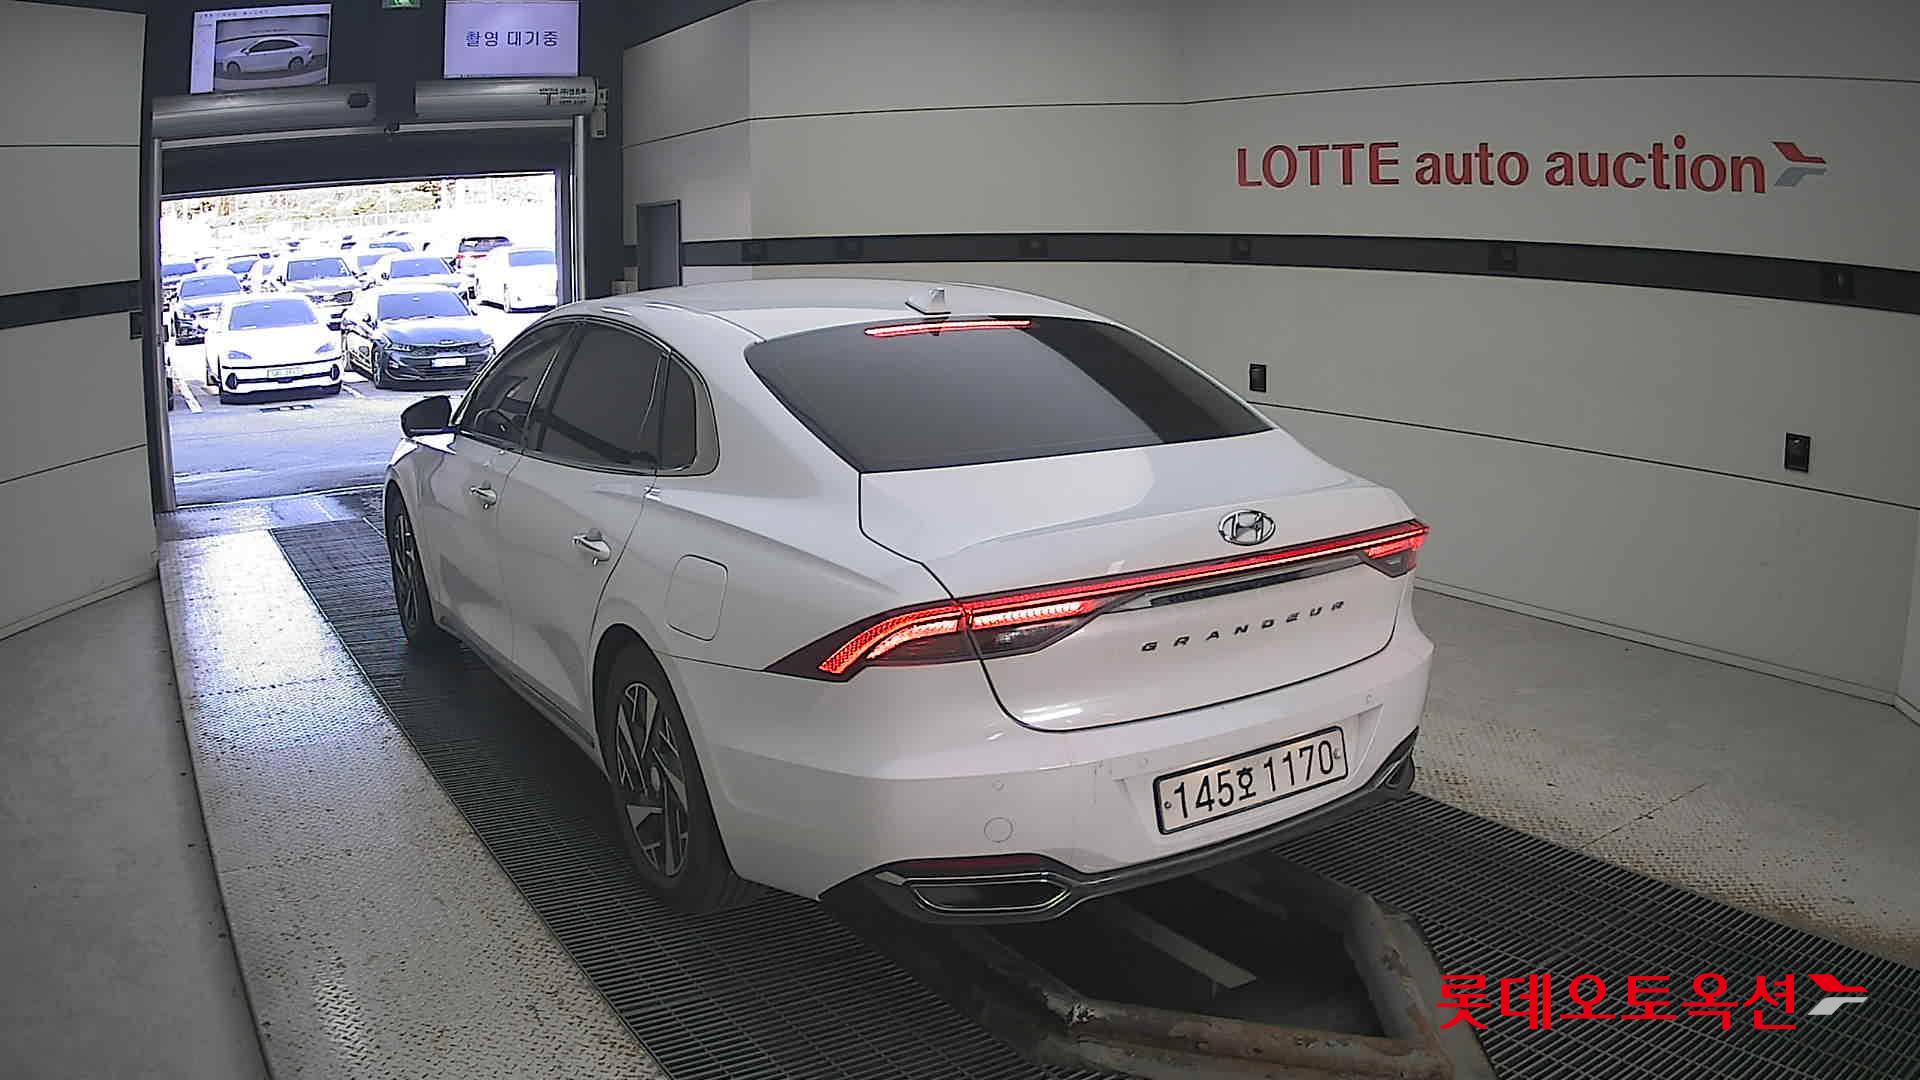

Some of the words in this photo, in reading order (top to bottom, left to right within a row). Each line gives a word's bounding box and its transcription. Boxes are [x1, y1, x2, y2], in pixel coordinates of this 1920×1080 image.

[465, 31, 498, 48] 촬영
[507, 31, 558, 47] 대기중
[1237, 142, 1400, 188] LOTTE
[1415, 142, 1529, 186] auto
[1545, 134, 1767, 193] auction
[1141, 600, 1345, 652] GRANDEUR
